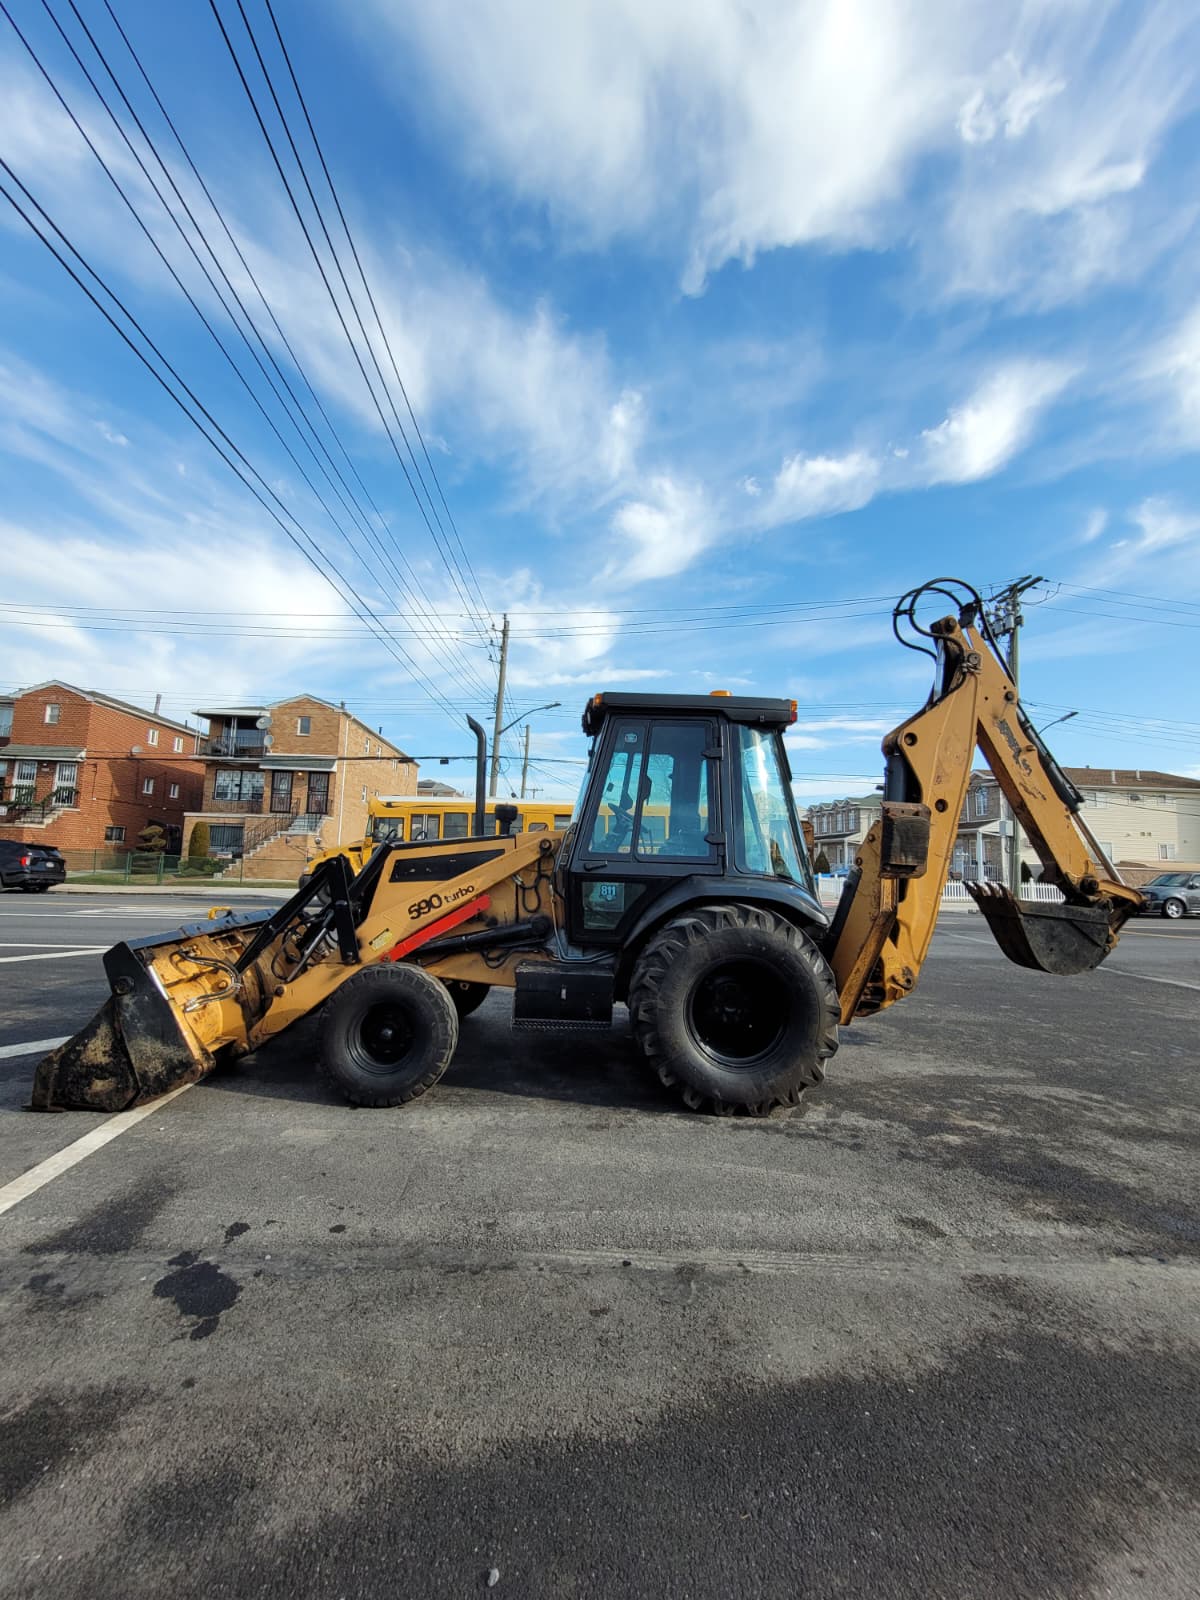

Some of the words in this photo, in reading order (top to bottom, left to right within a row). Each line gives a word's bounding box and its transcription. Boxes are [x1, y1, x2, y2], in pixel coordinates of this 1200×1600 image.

[601, 885, 616, 896] 811
[408, 893, 443, 920] 590
[444, 885, 474, 903] turbo
